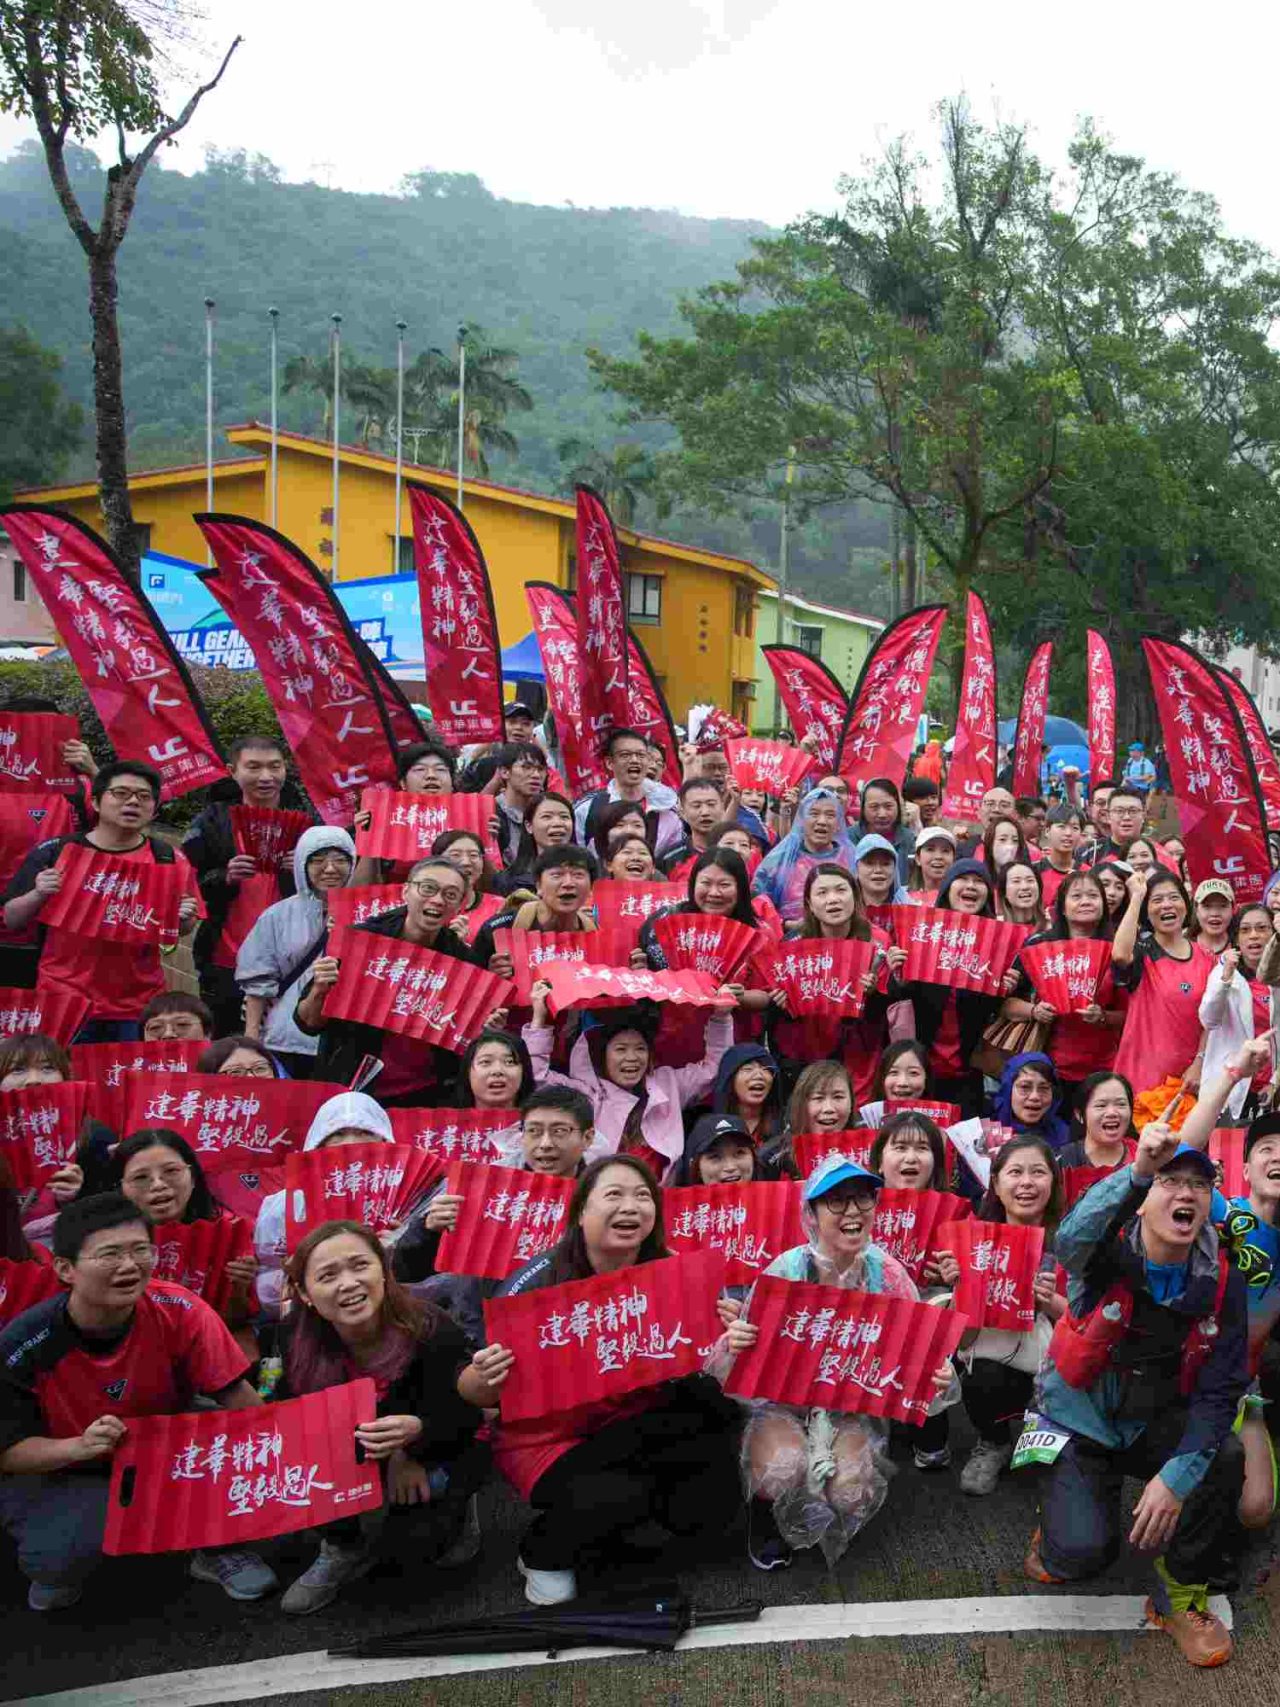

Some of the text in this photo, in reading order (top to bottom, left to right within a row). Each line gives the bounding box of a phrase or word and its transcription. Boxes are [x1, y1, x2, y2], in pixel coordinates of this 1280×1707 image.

[144, 1089, 261, 1131] 建華精神
[195, 1122, 293, 1153] 堅毅過人
[537, 1283, 648, 1350] 建華精神
[780, 1305, 882, 1362] 建華精神
[596, 1320, 693, 1375] 堅毅過人
[171, 1419, 283, 1485] 建華精神
[227, 1462, 335, 1519] 堅毅過人
